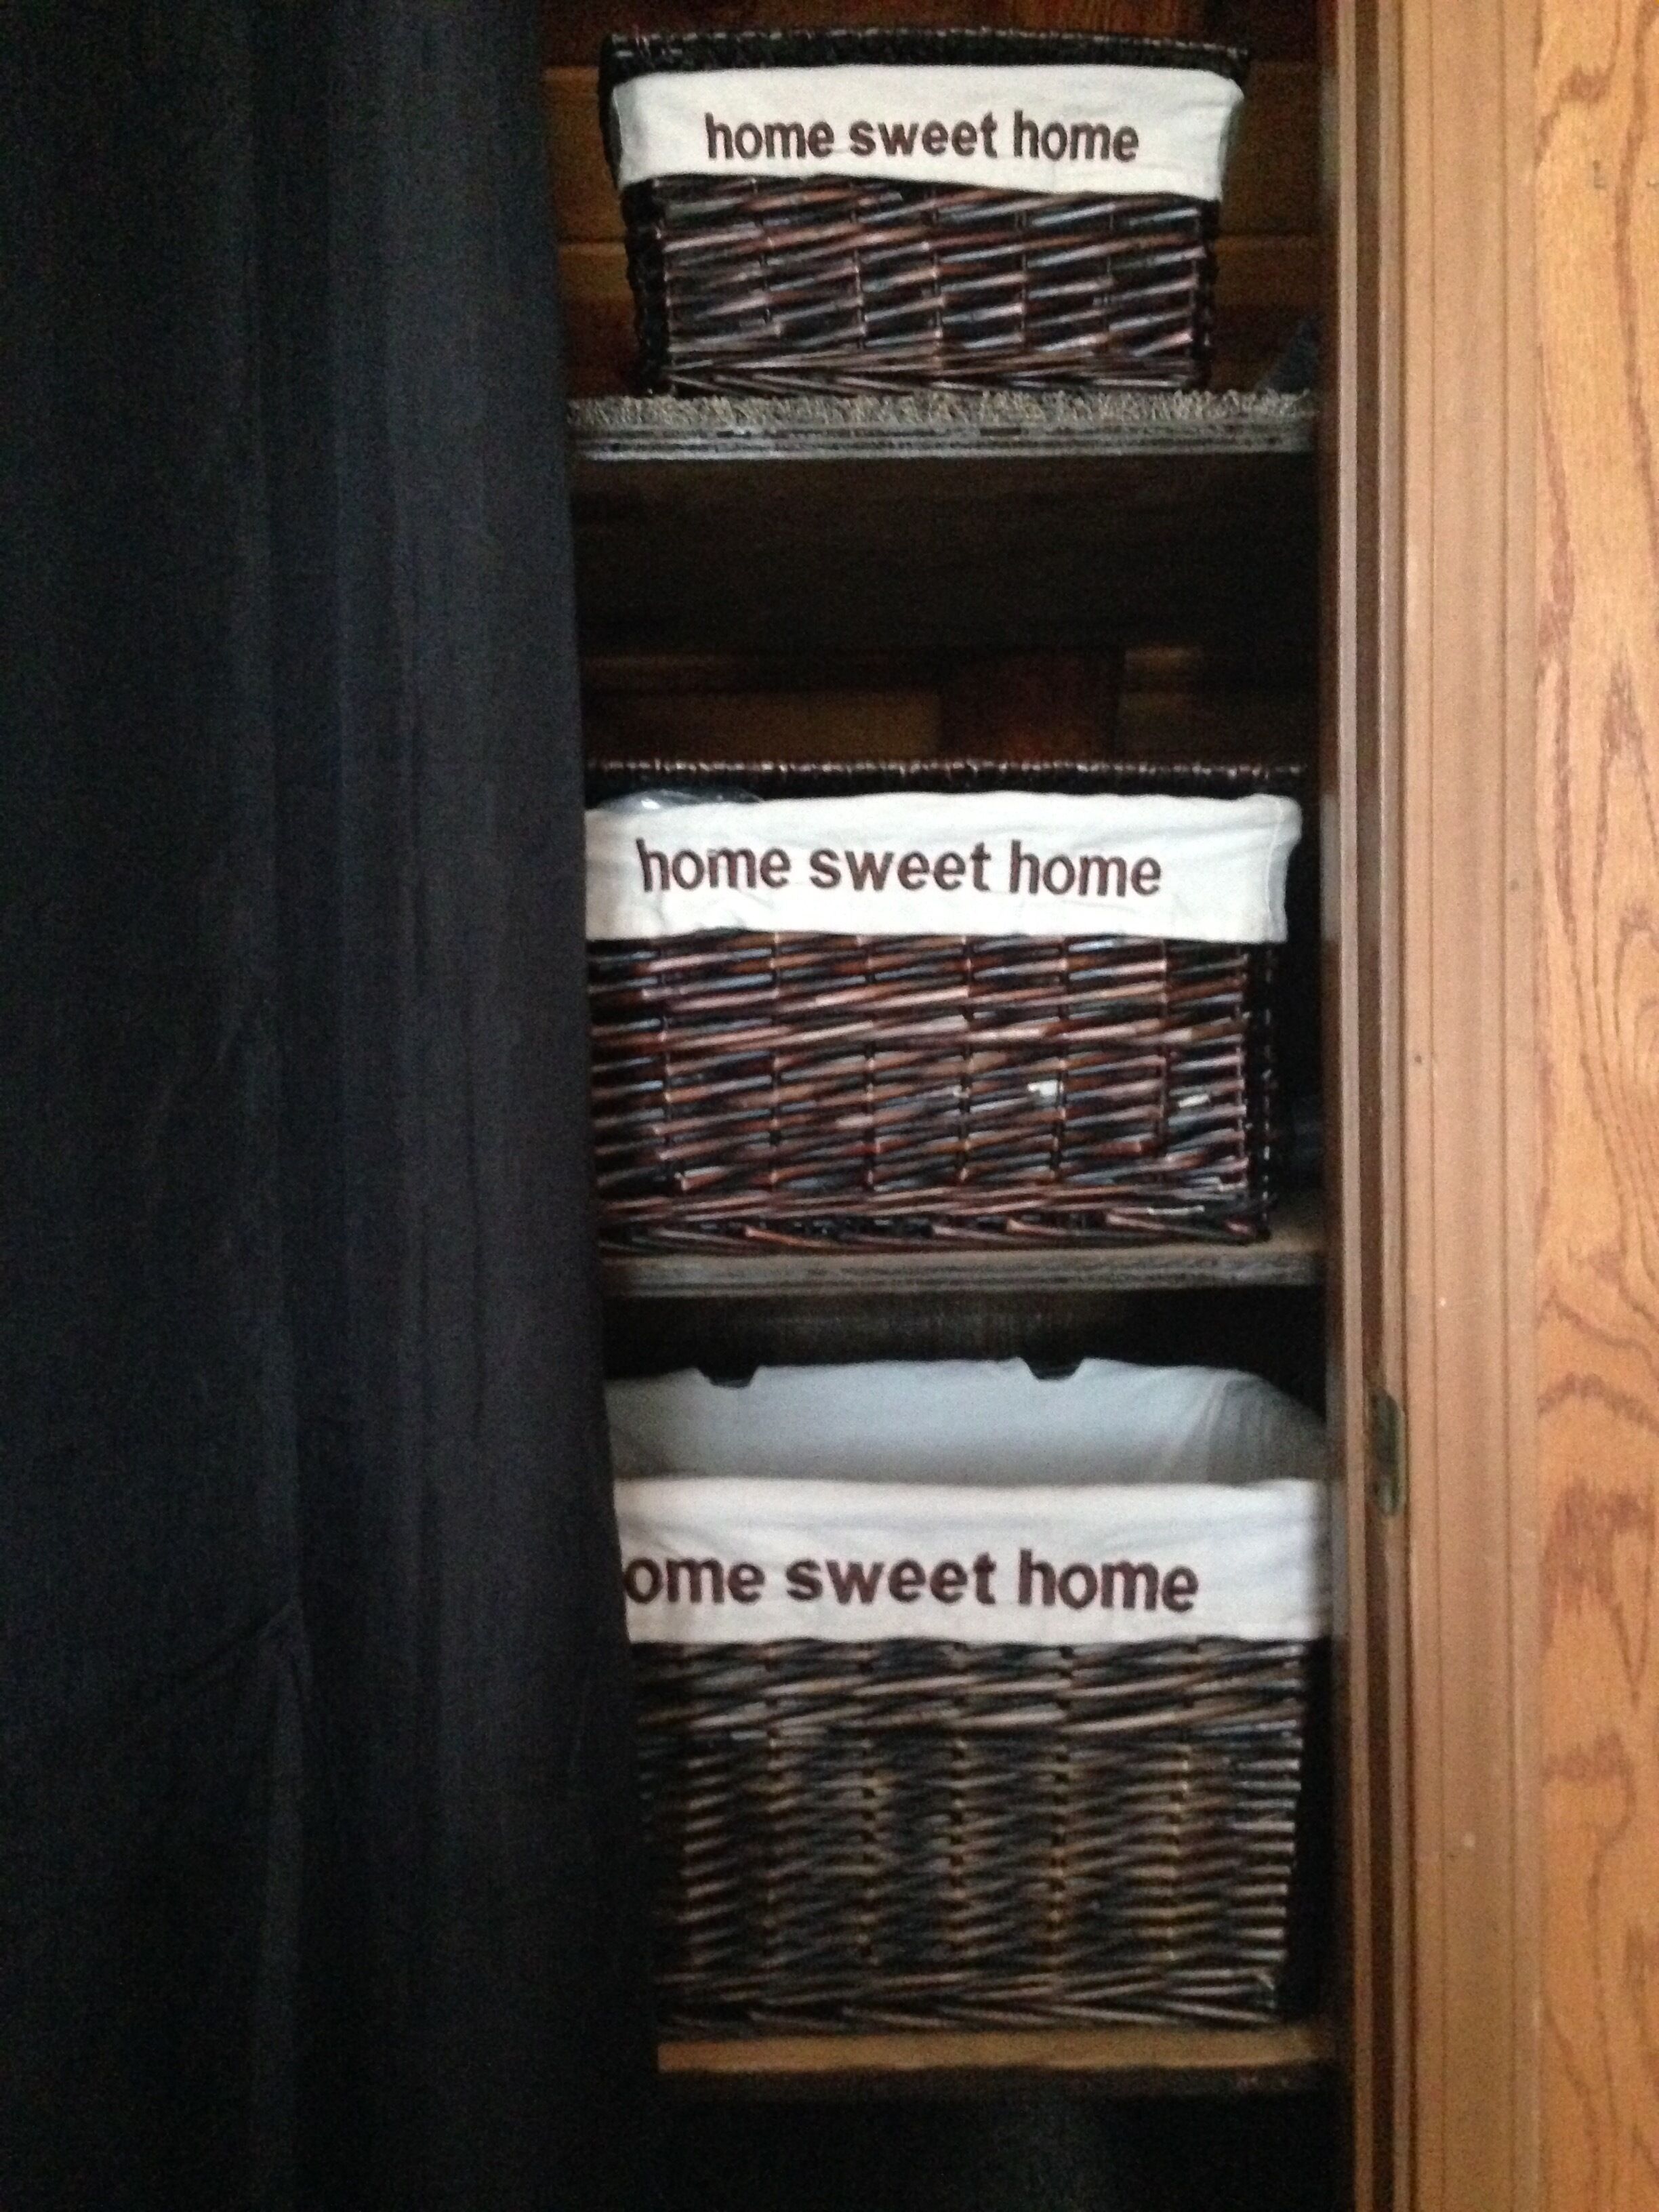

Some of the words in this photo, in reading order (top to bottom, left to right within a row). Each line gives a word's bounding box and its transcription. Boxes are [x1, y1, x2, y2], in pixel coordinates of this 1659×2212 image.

[705, 112, 834, 160] home
[848, 112, 998, 159] sweet
[1013, 110, 1139, 163] home
[636, 838, 790, 893] home
[810, 842, 991, 890] sweet
[1010, 840, 1161, 897] home
[623, 1558, 765, 1605] ome
[785, 1552, 997, 1605] sweet
[1018, 1549, 1199, 1614] home
